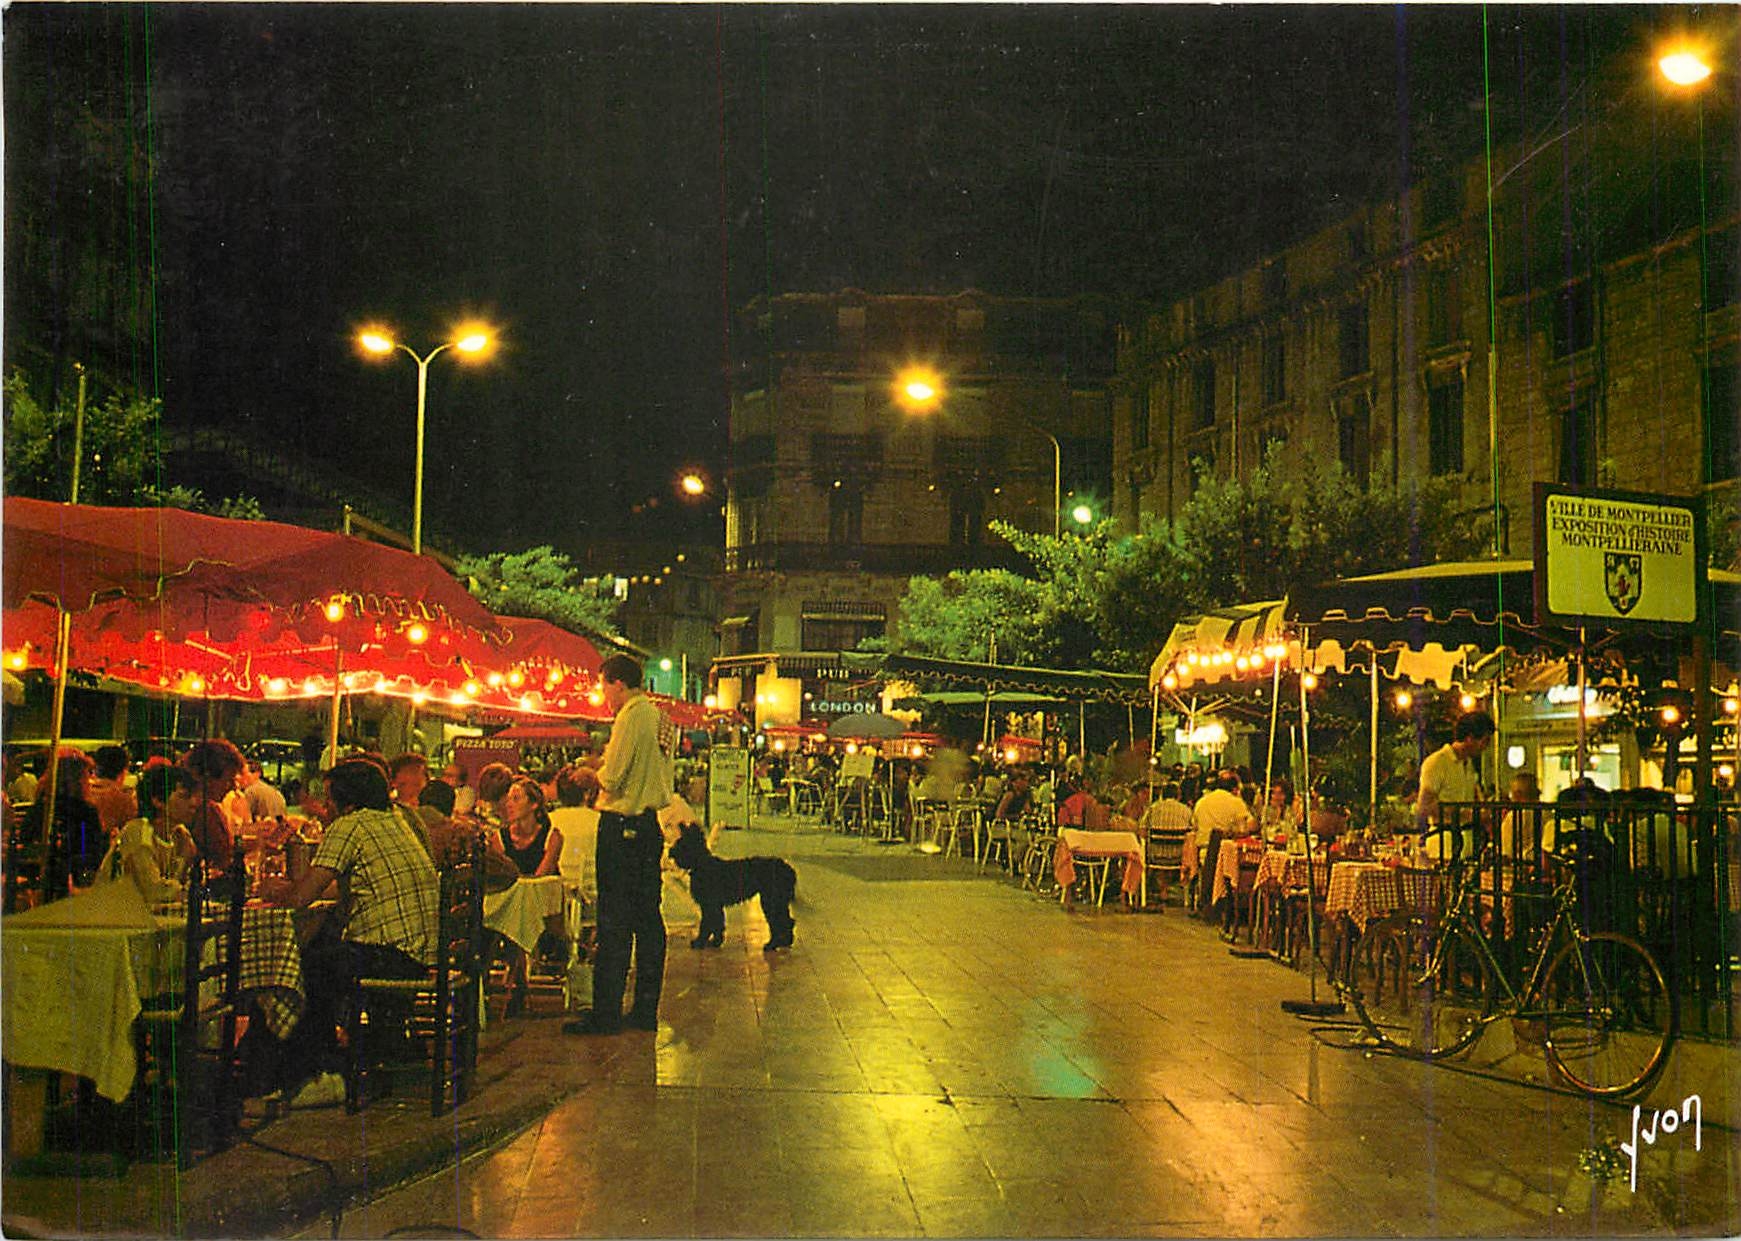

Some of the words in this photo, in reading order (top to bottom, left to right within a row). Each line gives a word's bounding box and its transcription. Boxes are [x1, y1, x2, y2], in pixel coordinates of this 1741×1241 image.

[1551, 501, 1586, 517] VILLE
[1588, 505, 1603, 518] DE
[1607, 507, 1691, 528] MONTPELLIER
[1553, 517, 1626, 536] EXPOSITION
[1562, 532, 1683, 556] MONTPELLIERAINE
[817, 667, 849, 679] PUB
[810, 701, 877, 715] LONDON
[455, 738, 486, 749] PIZZA
